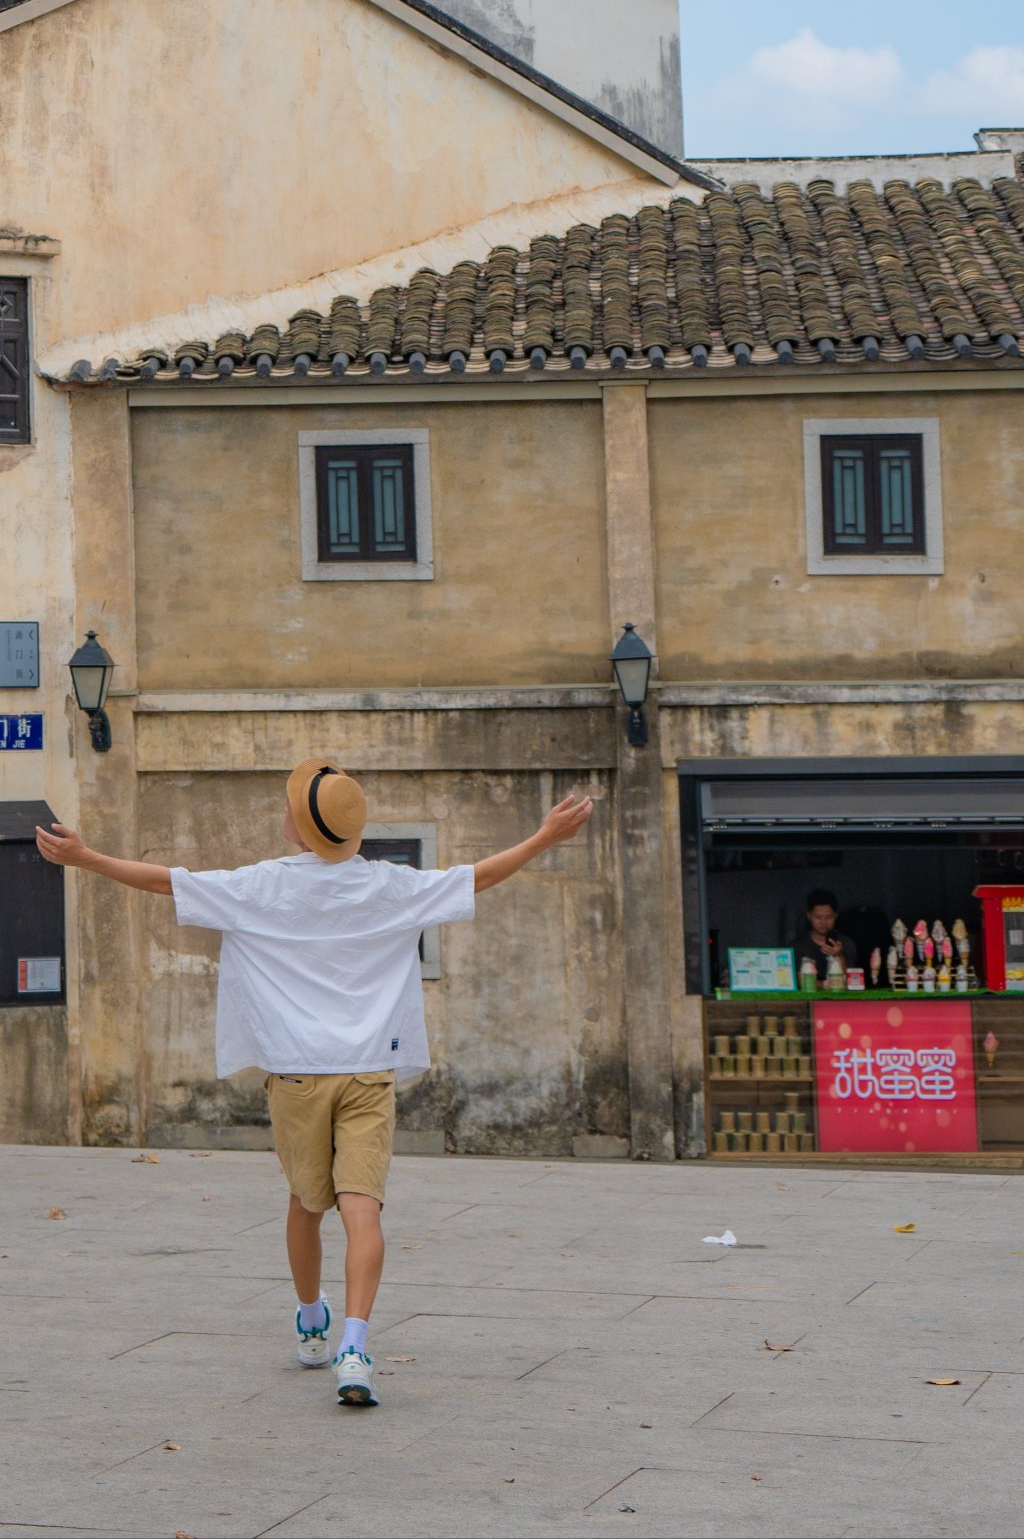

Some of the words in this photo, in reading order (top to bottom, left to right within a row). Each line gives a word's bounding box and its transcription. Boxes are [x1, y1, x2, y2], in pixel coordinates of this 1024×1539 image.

[12, 740, 26, 748] JIE
[833, 1046, 957, 1100] 甜蜜蜜
